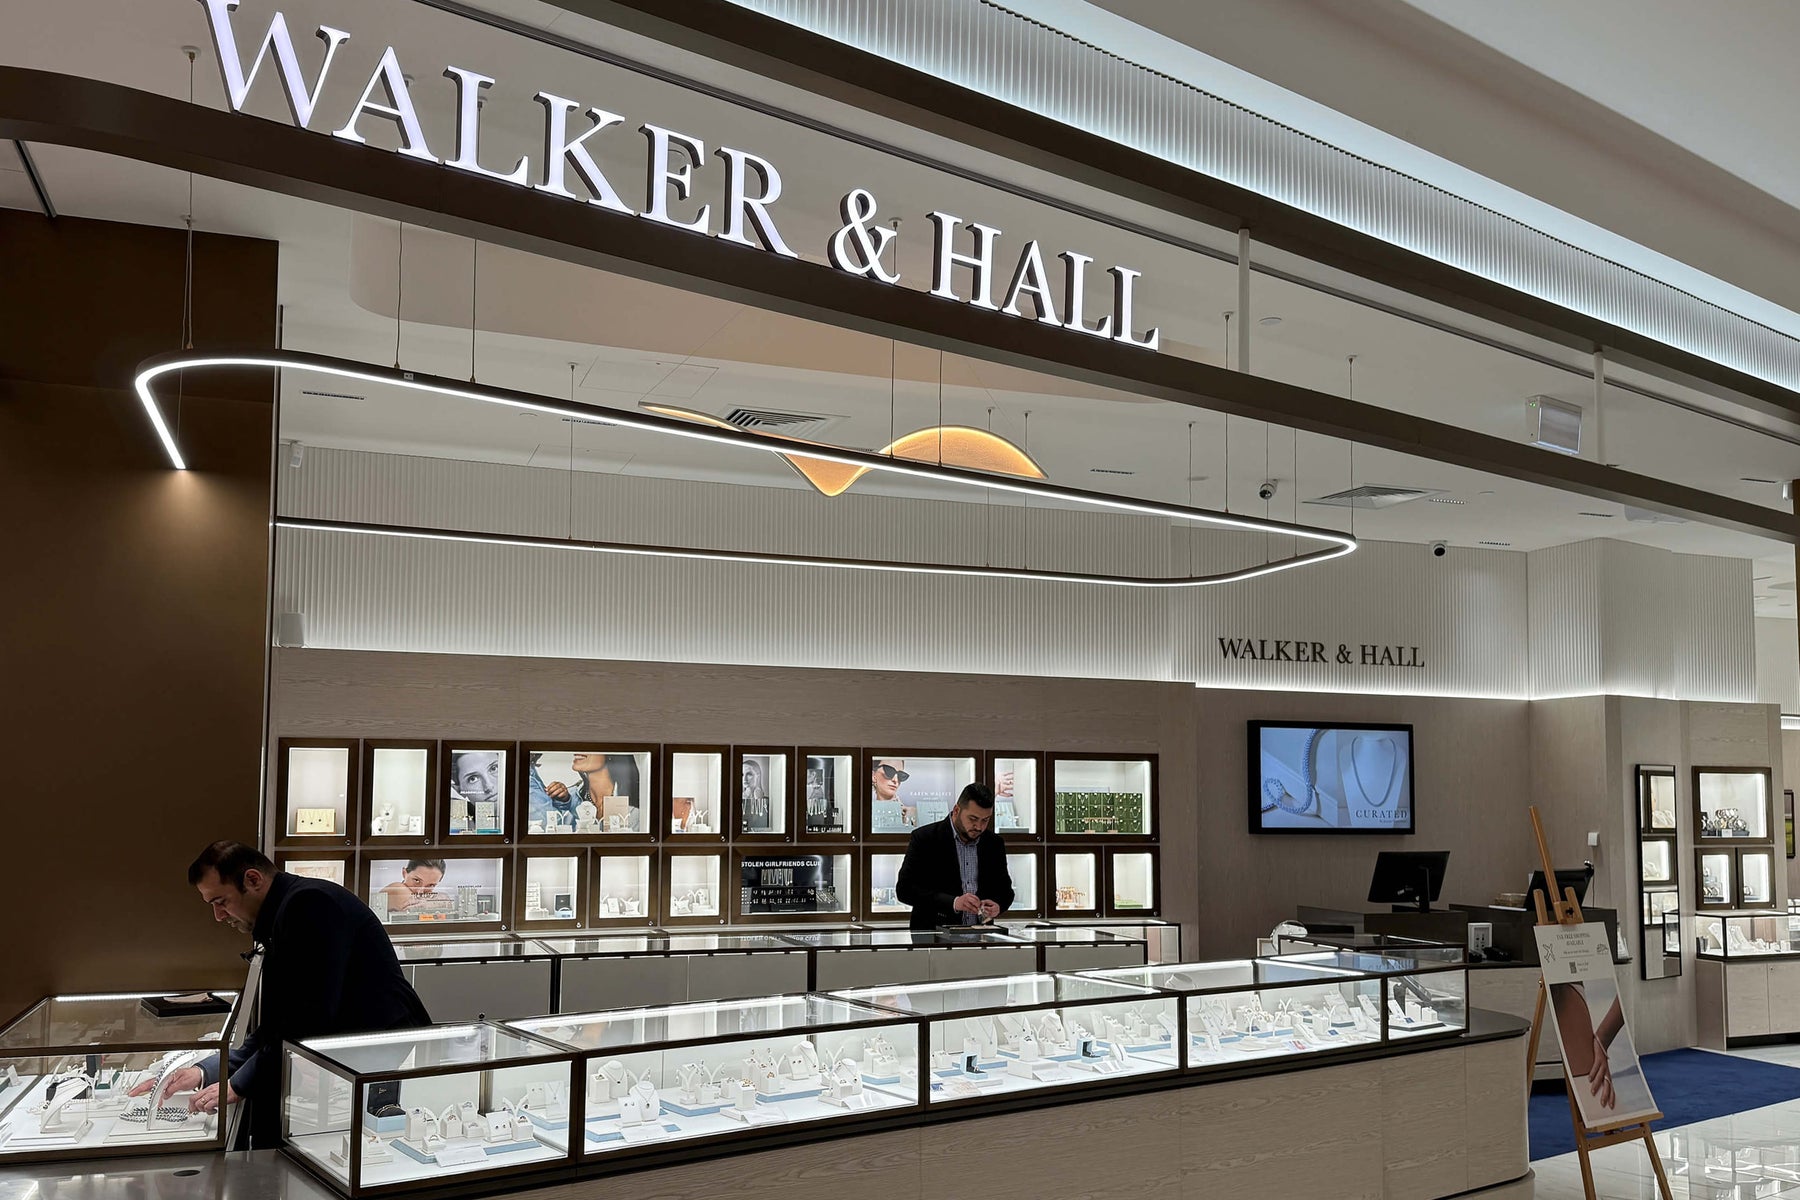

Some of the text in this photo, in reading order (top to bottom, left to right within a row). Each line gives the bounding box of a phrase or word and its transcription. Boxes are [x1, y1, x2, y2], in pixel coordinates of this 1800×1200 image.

[198, 0, 1159, 351] WALKER & HALL
[1218, 637, 1425, 668] WALKER & HALL
[1355, 809, 1408, 819] CURATED
